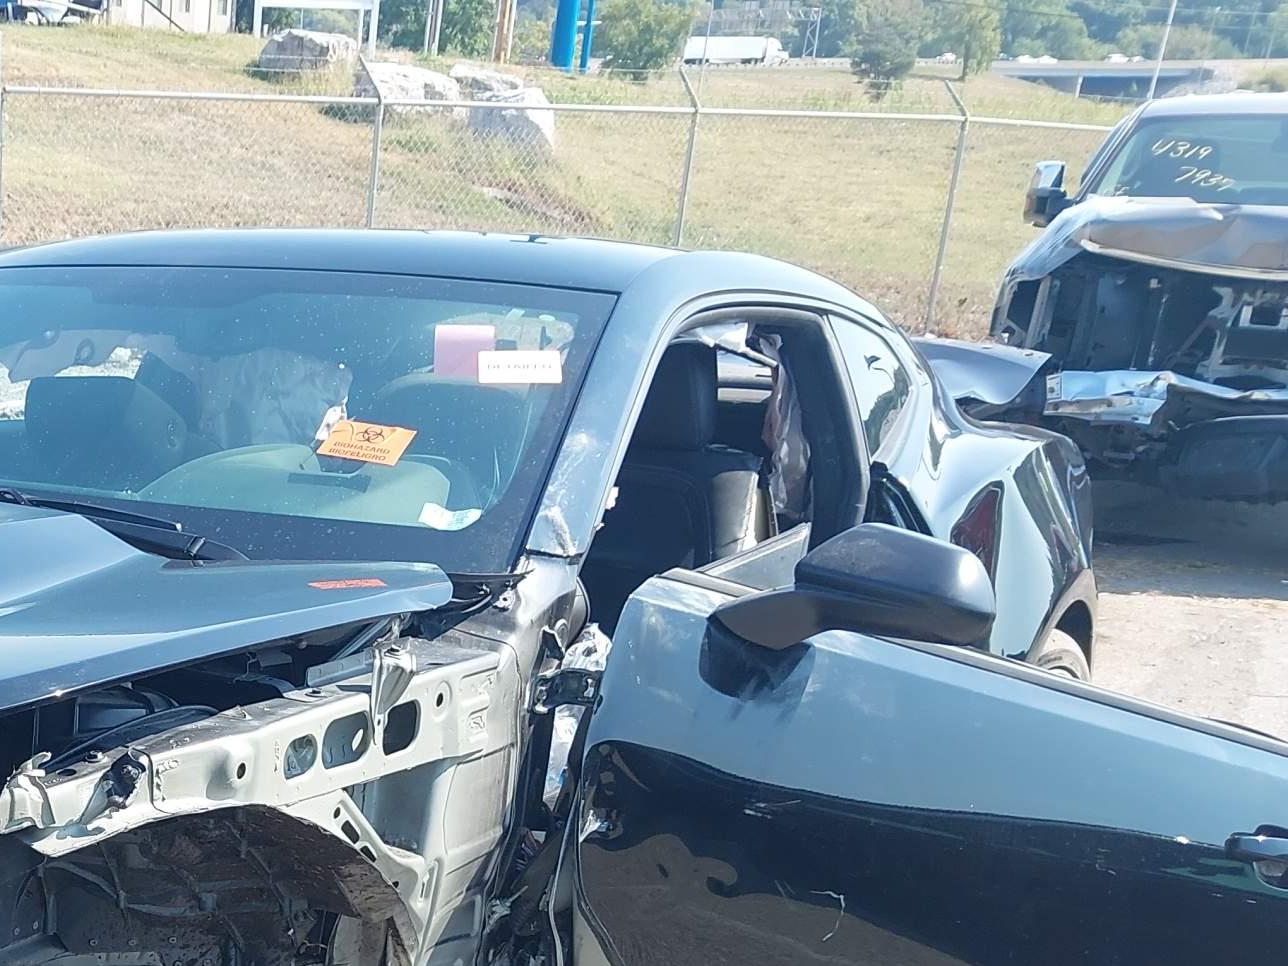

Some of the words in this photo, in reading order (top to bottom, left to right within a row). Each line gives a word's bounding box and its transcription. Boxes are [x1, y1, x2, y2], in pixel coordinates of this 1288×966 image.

[1152, 138, 1213, 160] 4319
[328, 448, 387, 461] BIOPELIGRO
[333, 441, 391, 455] BIOHAZARD
